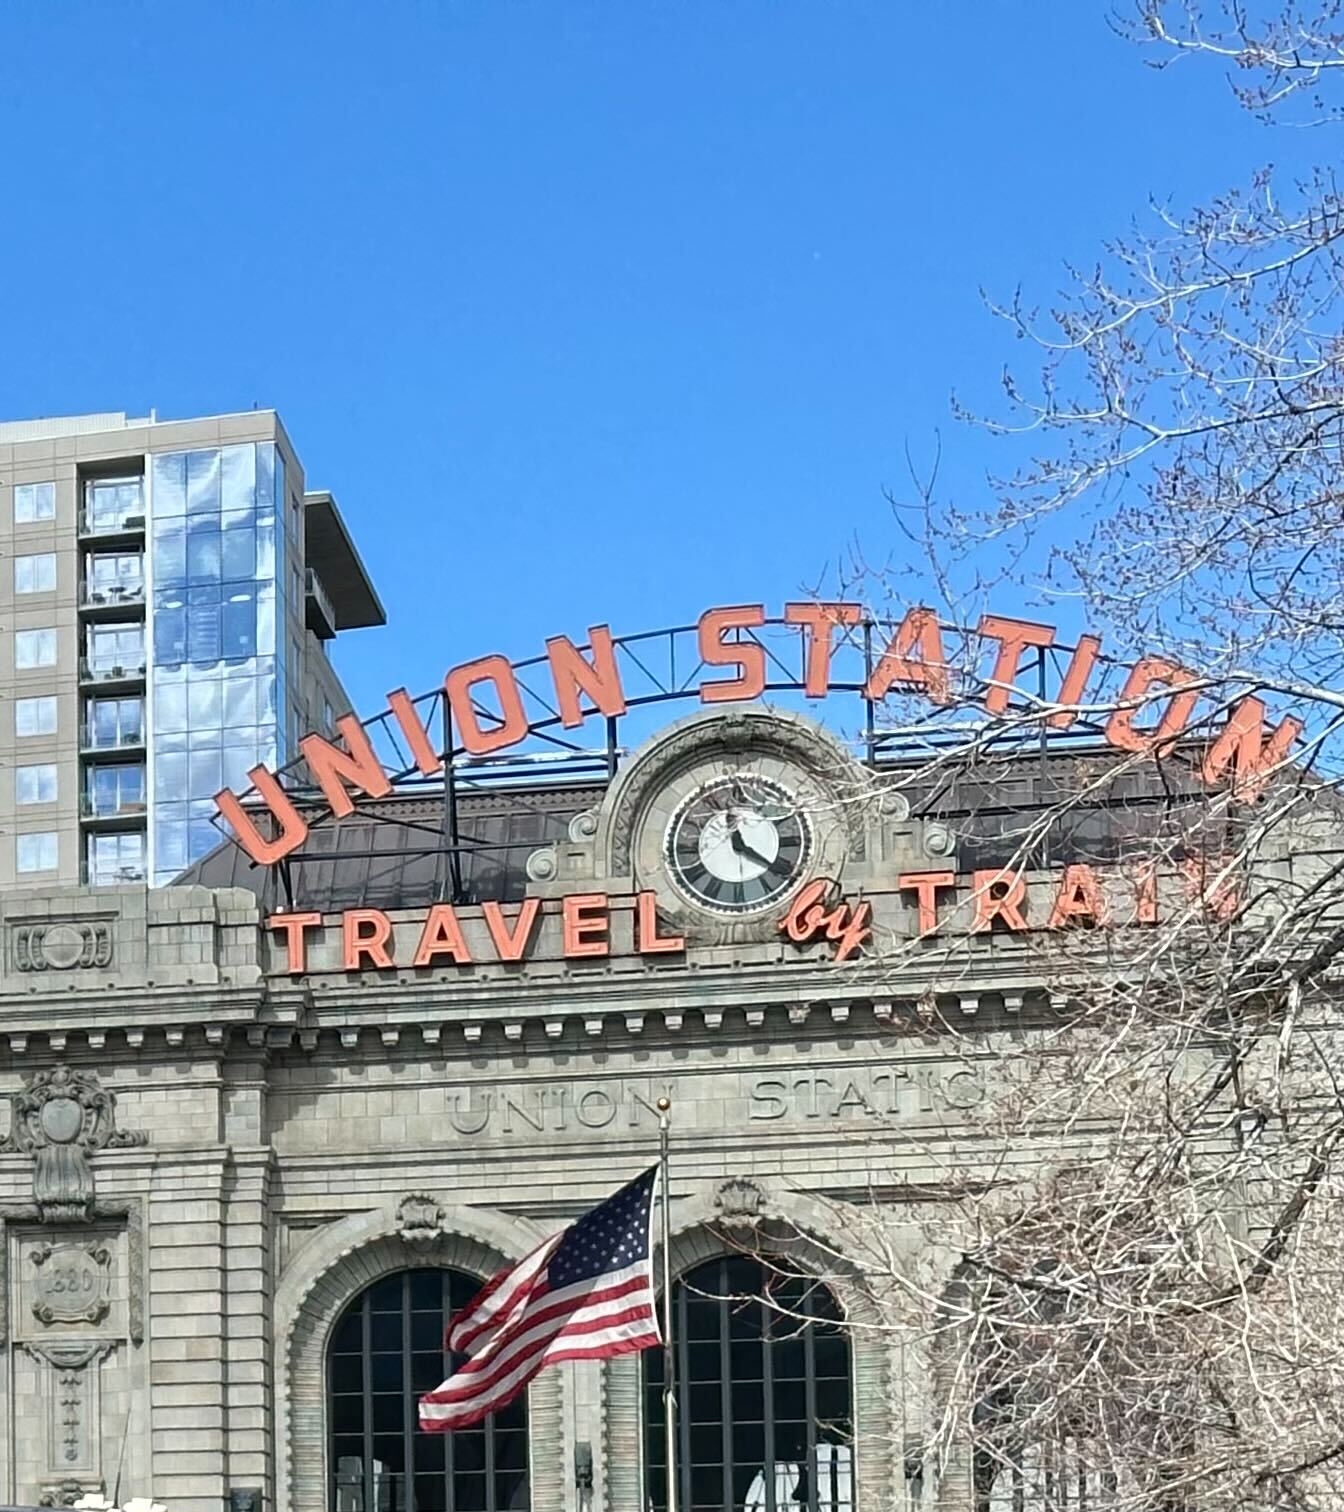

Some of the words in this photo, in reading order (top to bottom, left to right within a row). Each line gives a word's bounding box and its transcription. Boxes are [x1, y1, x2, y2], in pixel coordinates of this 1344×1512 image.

[213, 623, 628, 865] UNION
[697, 602, 1305, 802] STATION
[270, 889, 686, 974] TRAVEL
[778, 879, 874, 961] by
[447, 1086, 673, 1135] UNION
[750, 1071, 988, 1120] STATIO
